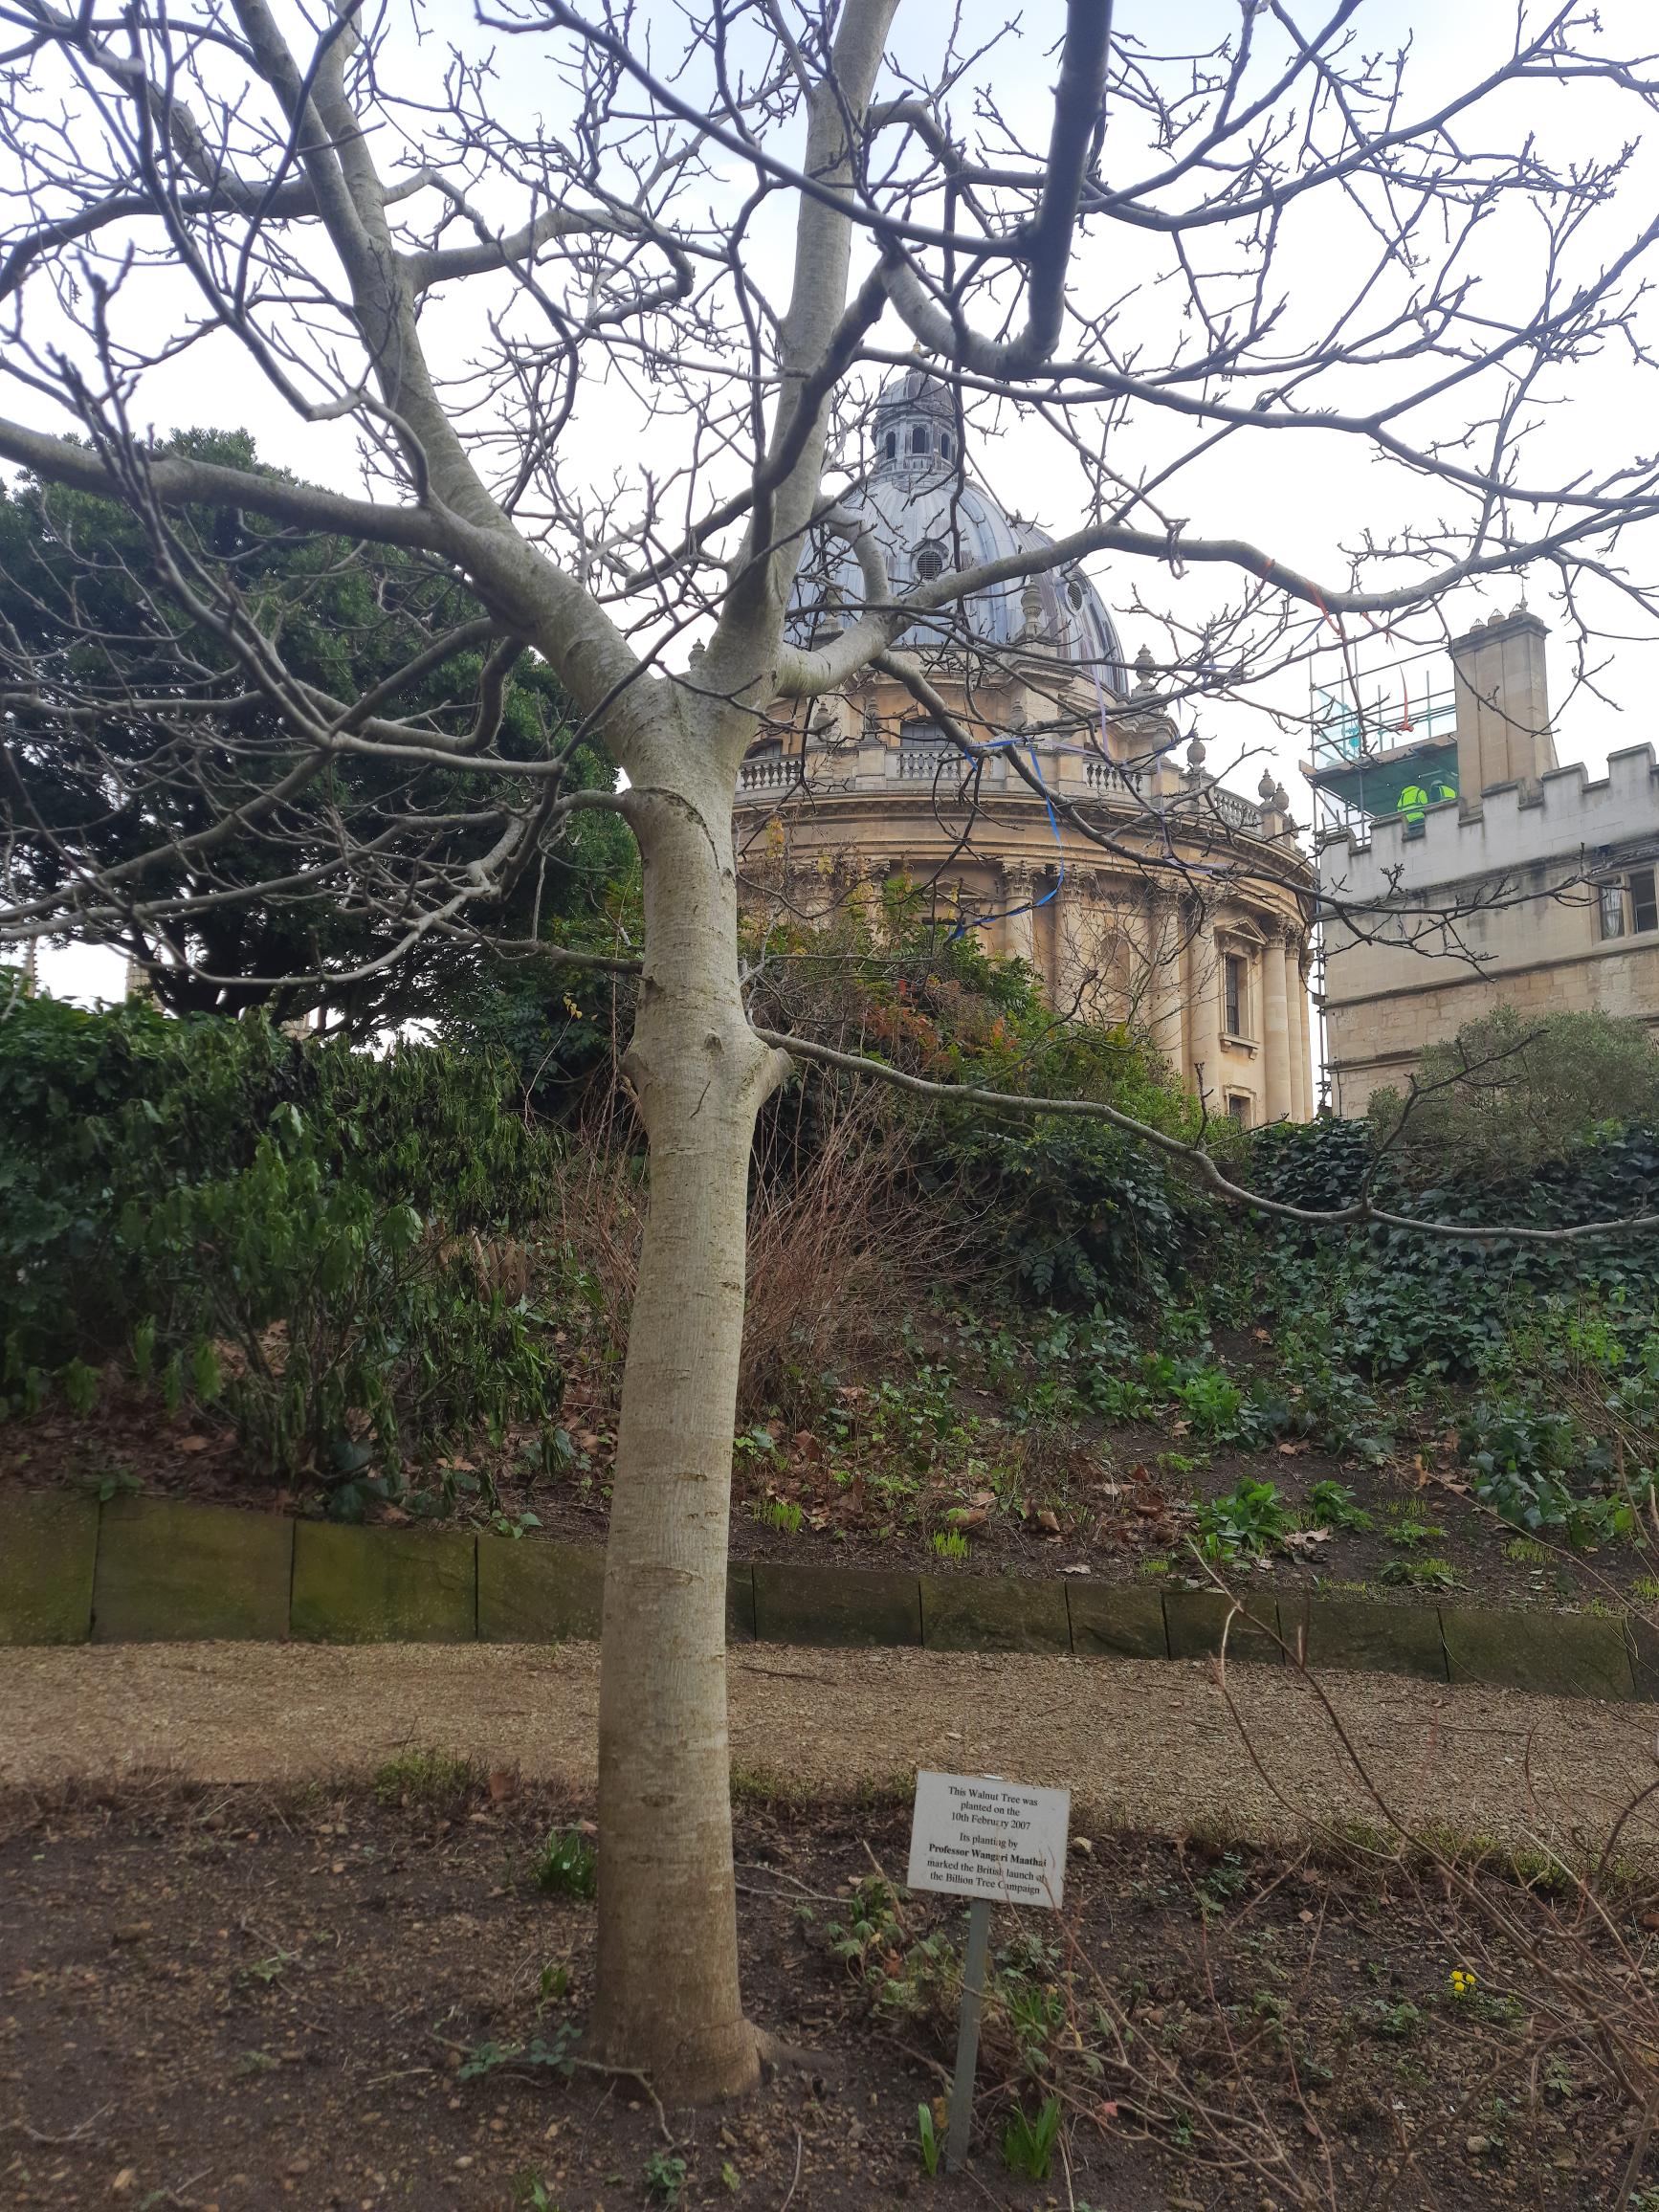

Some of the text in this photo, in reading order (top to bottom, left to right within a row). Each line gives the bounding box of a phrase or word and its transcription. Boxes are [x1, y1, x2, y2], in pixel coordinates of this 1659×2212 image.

[949, 1786, 1038, 1806] This Walnut Tree was
[961, 1802, 1021, 1817] planted on the
[952, 1812, 969, 1823] 10th
[1010, 1821, 1030, 1830] 2007
[960, 1833, 1018, 1850] Its planting by
[928, 1844, 969, 1856] Professor
[1010, 1855, 1047, 1867] Maathai
[927, 1860, 959, 1870] marked
[961, 1863, 975, 1872] the
[1006, 1869, 1034, 1880] launch
[931, 1871, 943, 1881] the
[945, 1873, 973, 1885] Billion
[976, 1878, 996, 1888] Tree
